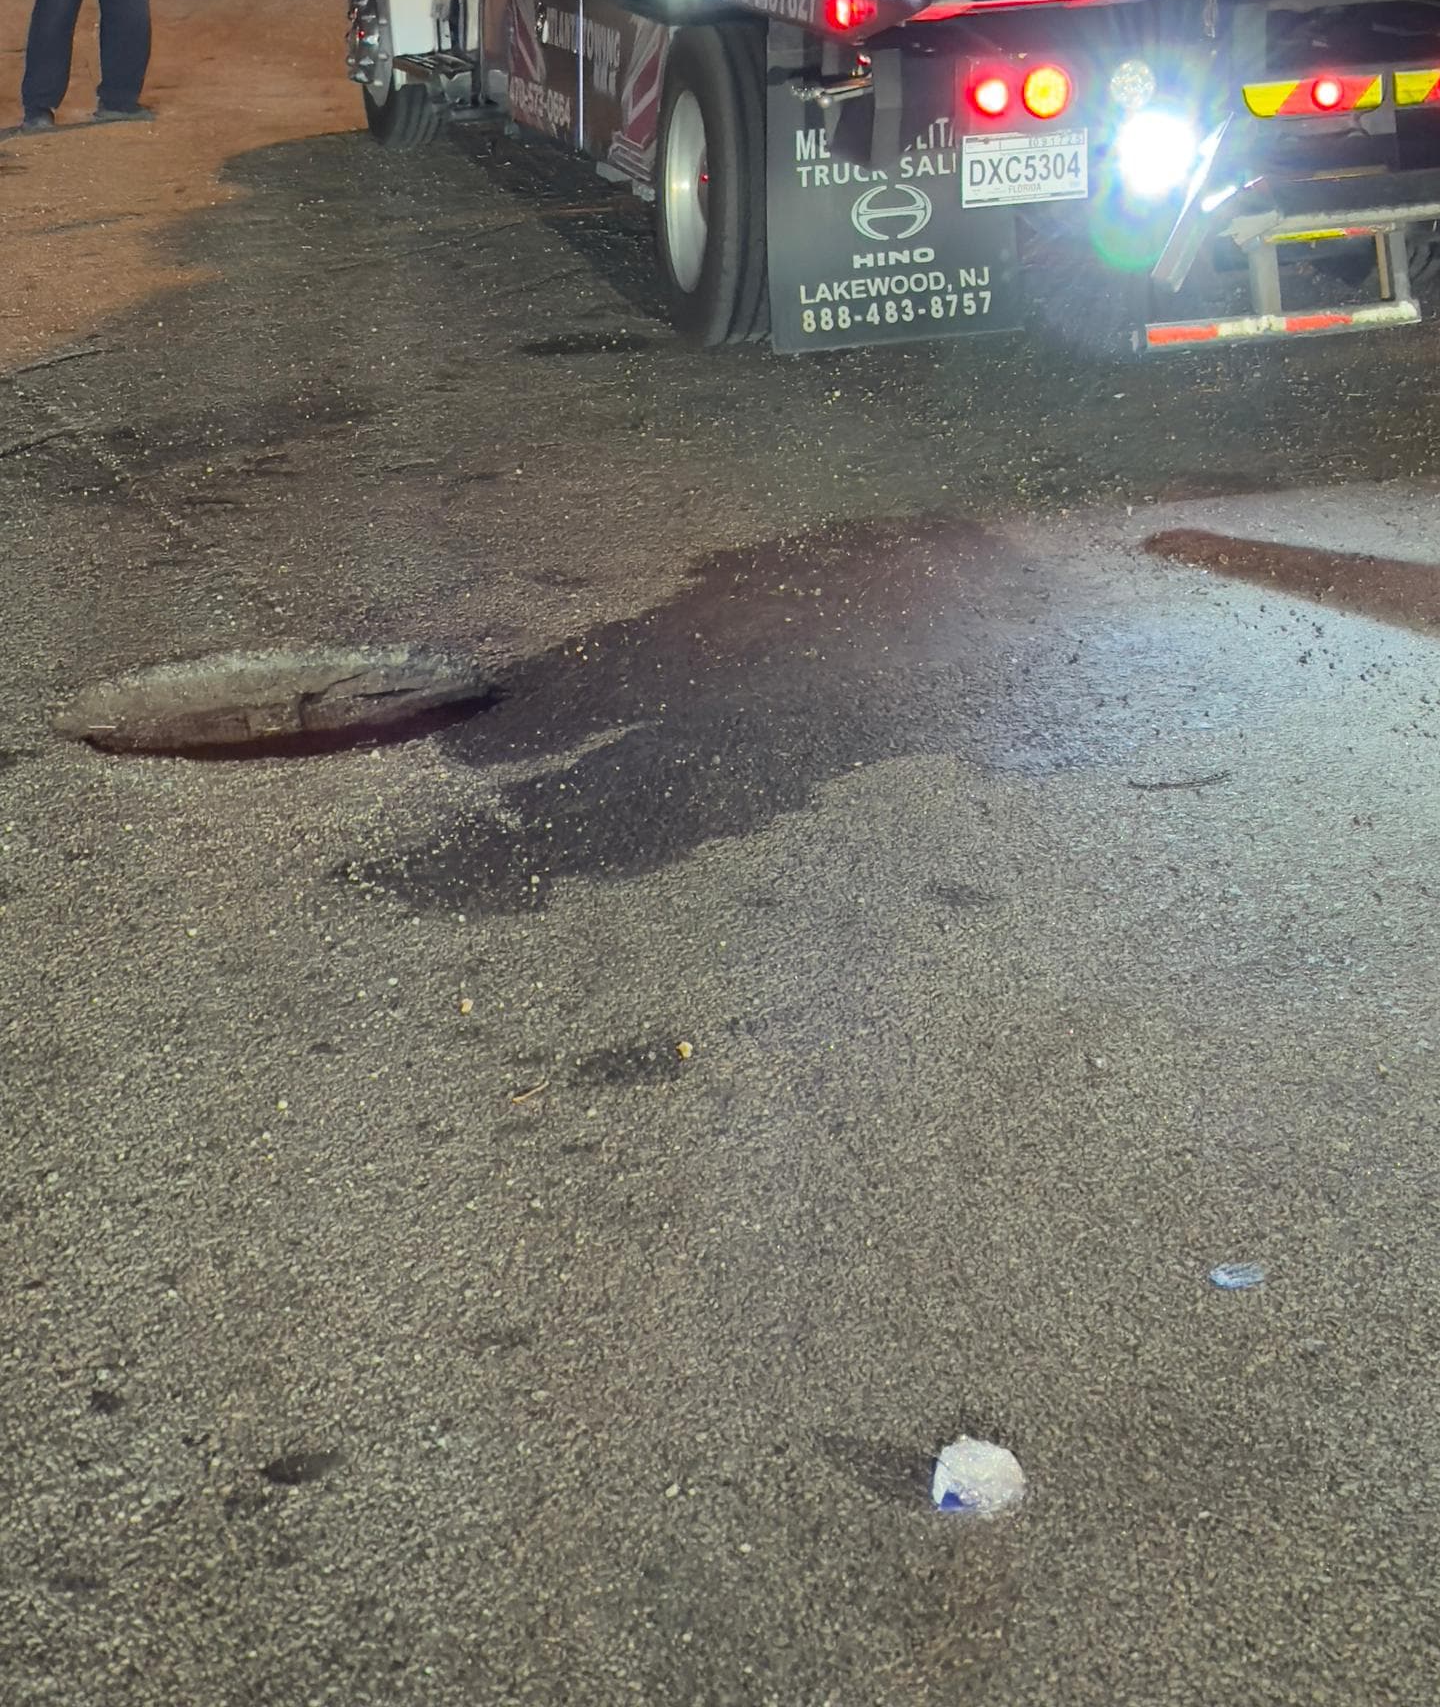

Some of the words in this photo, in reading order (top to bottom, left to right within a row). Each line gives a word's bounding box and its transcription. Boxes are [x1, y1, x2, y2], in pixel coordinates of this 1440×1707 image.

[900, 151, 957, 179] SAL
[969, 151, 1080, 187] DXC5304
[852, 246, 935, 269] HINO
[799, 270, 952, 304] LAKEWOOD,
[959, 267, 990, 286] NJ
[801, 291, 992, 334] 888-483-8757
